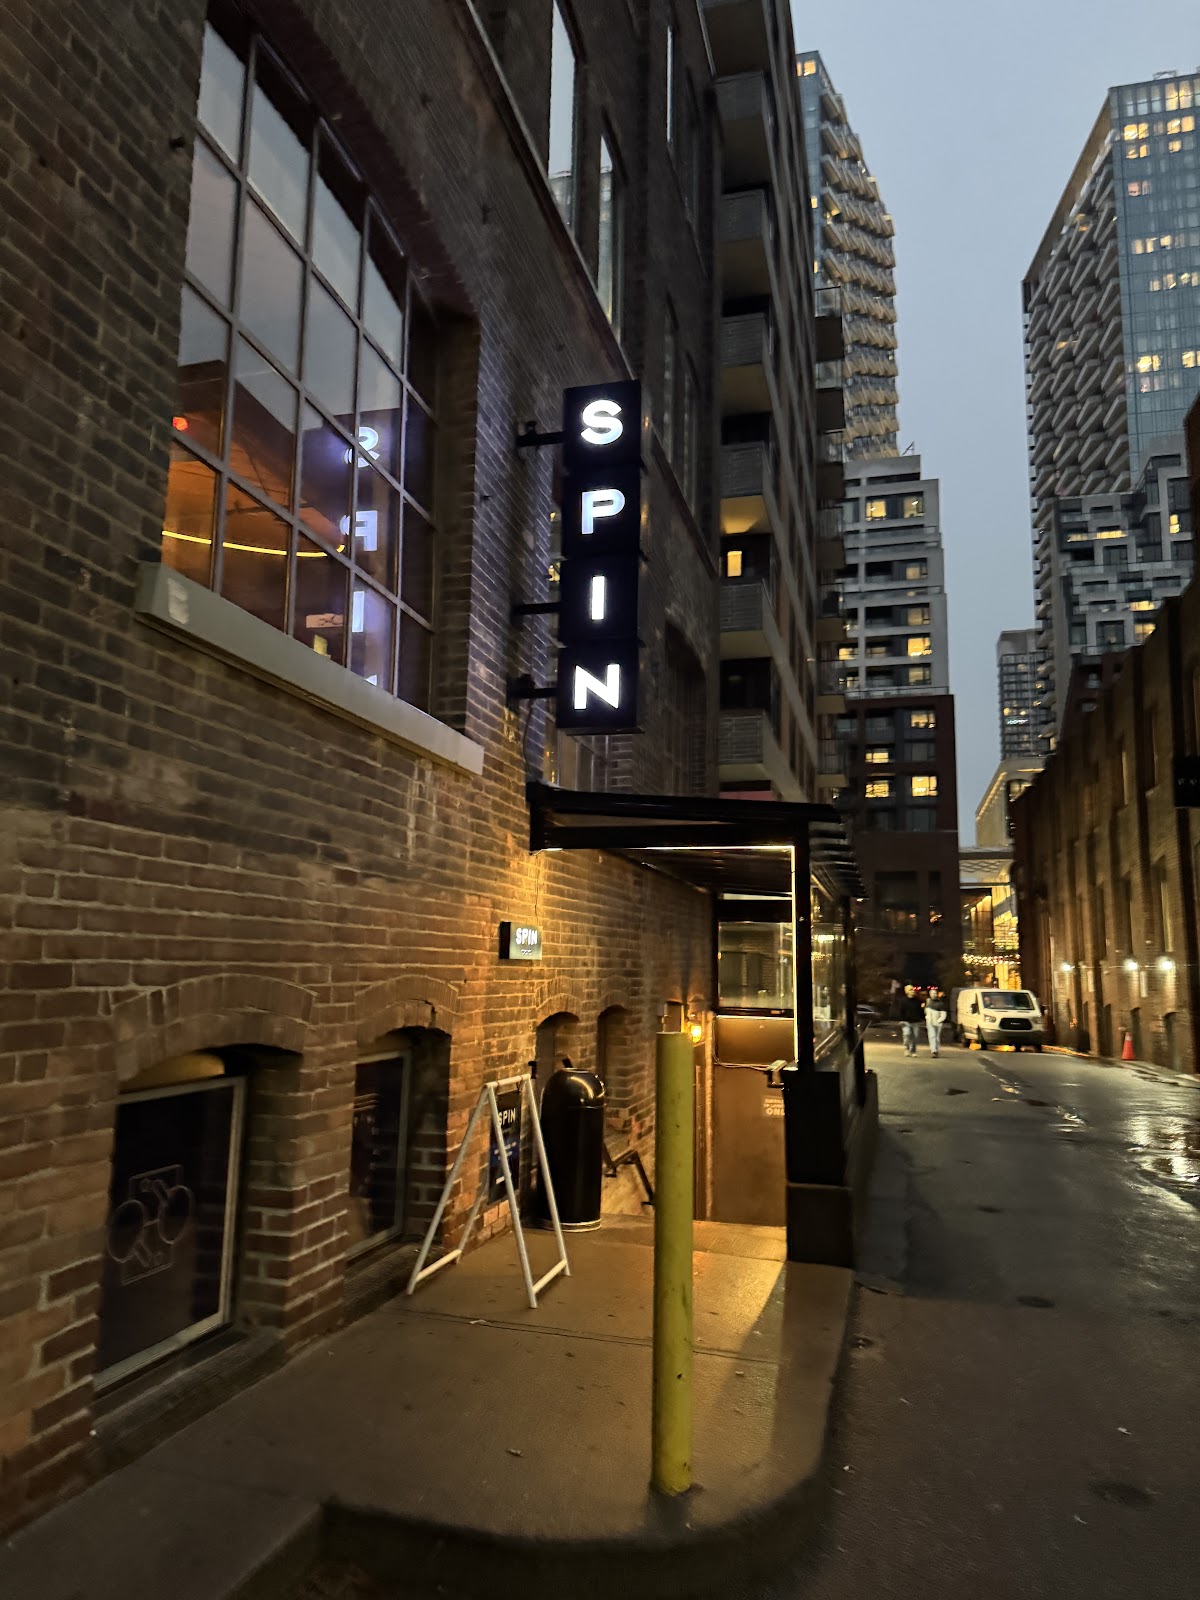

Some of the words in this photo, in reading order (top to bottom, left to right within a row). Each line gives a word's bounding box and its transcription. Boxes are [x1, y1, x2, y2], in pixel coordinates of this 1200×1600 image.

[573, 399, 626, 710] SPIN
[516, 927, 538, 945] SPIN
[498, 1108, 516, 1125] SPIN
